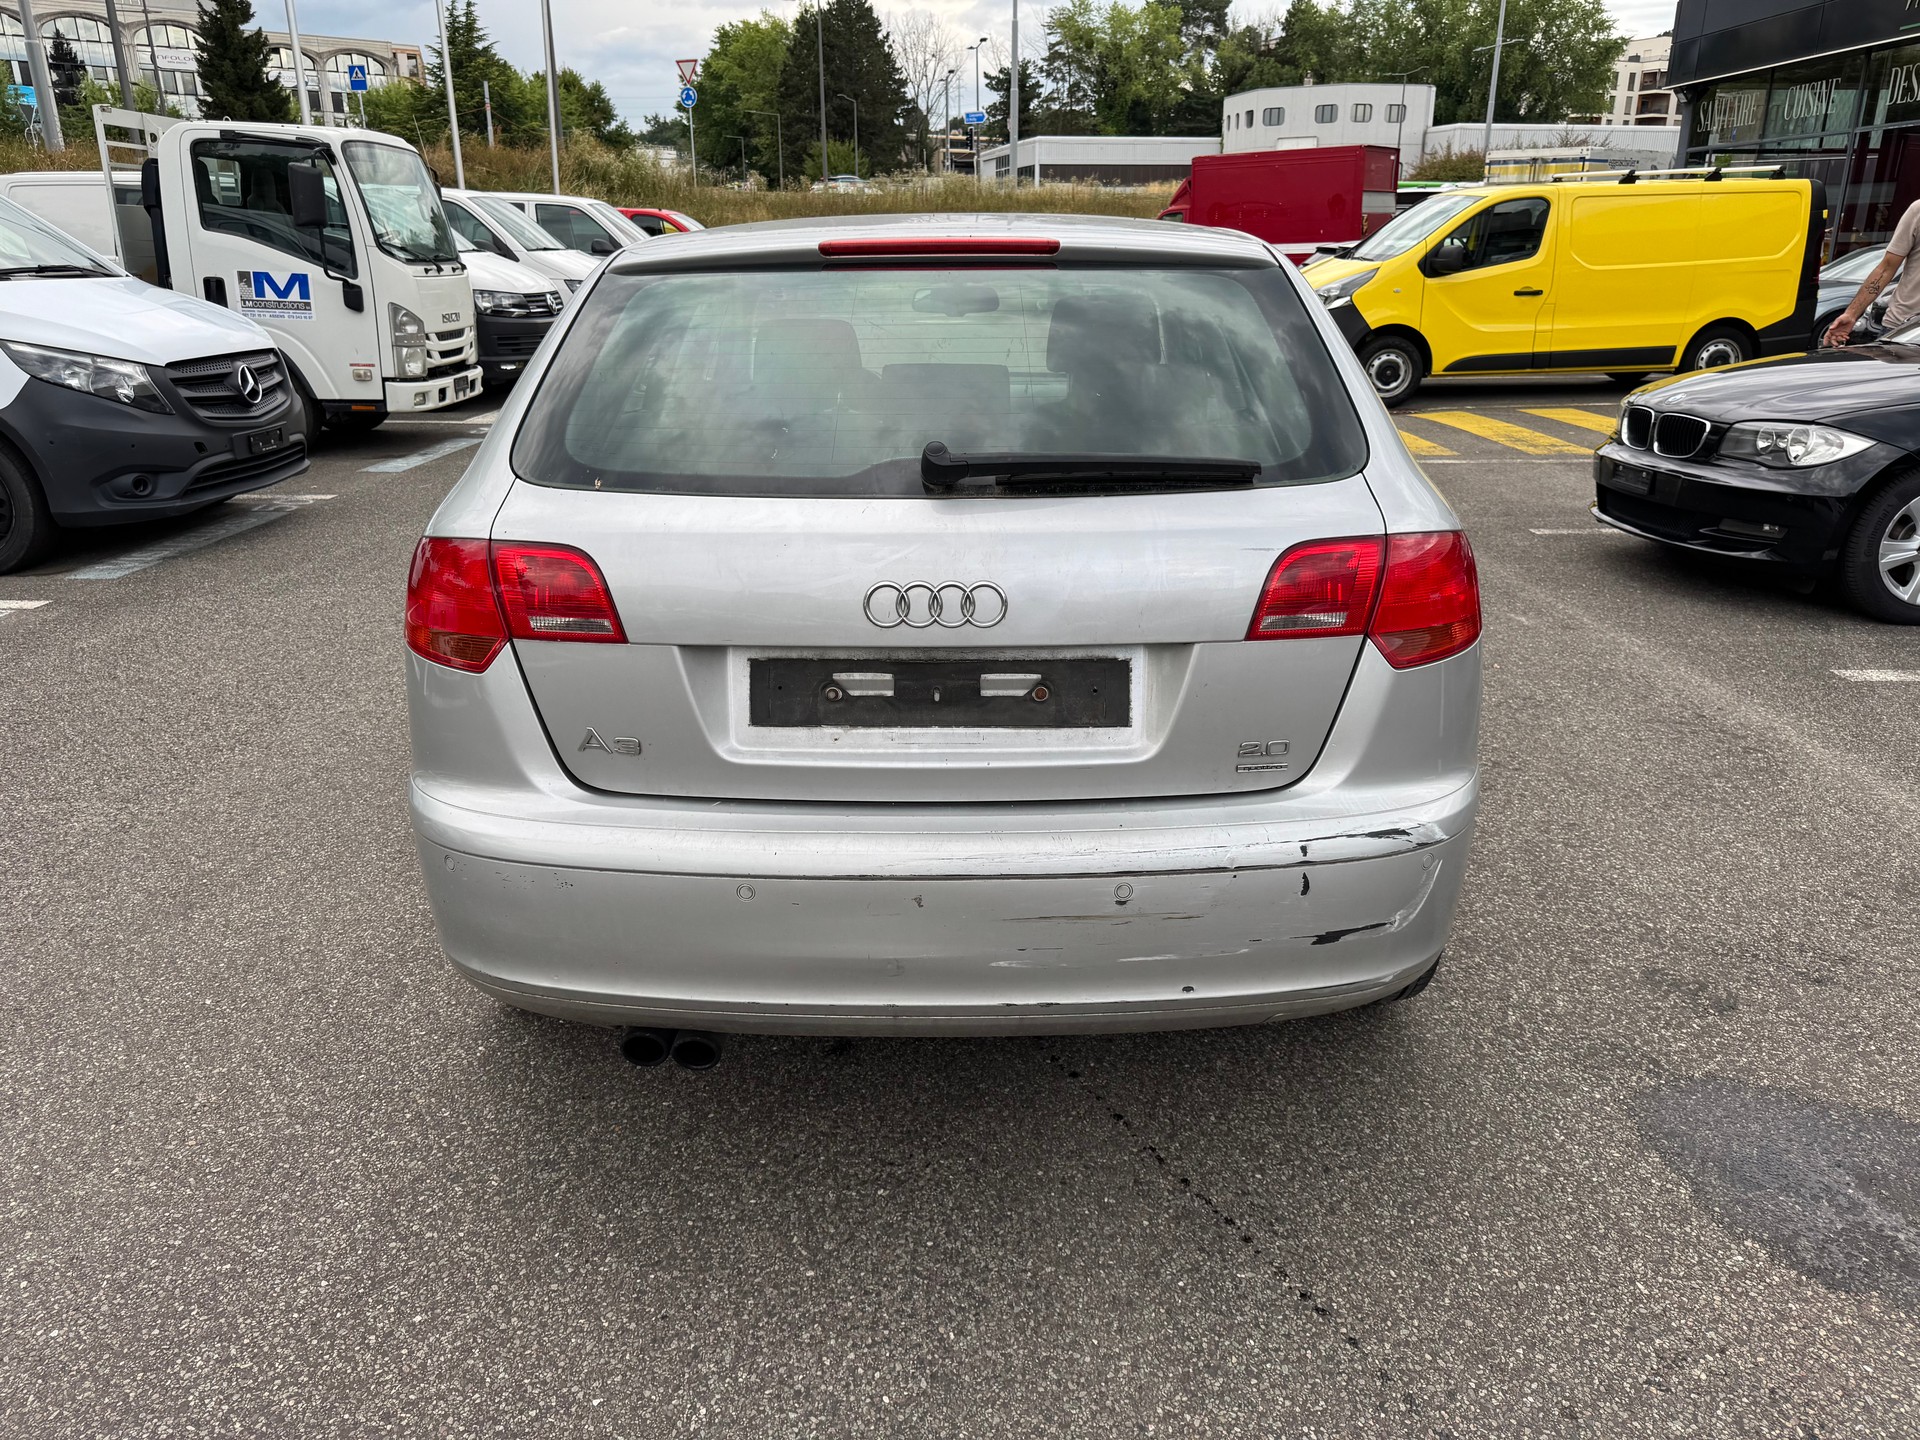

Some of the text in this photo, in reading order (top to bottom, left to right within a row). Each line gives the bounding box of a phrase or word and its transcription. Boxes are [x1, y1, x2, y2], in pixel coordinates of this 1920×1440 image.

[1697, 92, 1759, 132] SANITAIRE
[1783, 78, 1841, 120] CUISINE
[442, 312, 461, 323] ISUZU
[578, 726, 642, 756] A3
[1238, 740, 1290, 757] 2.0
